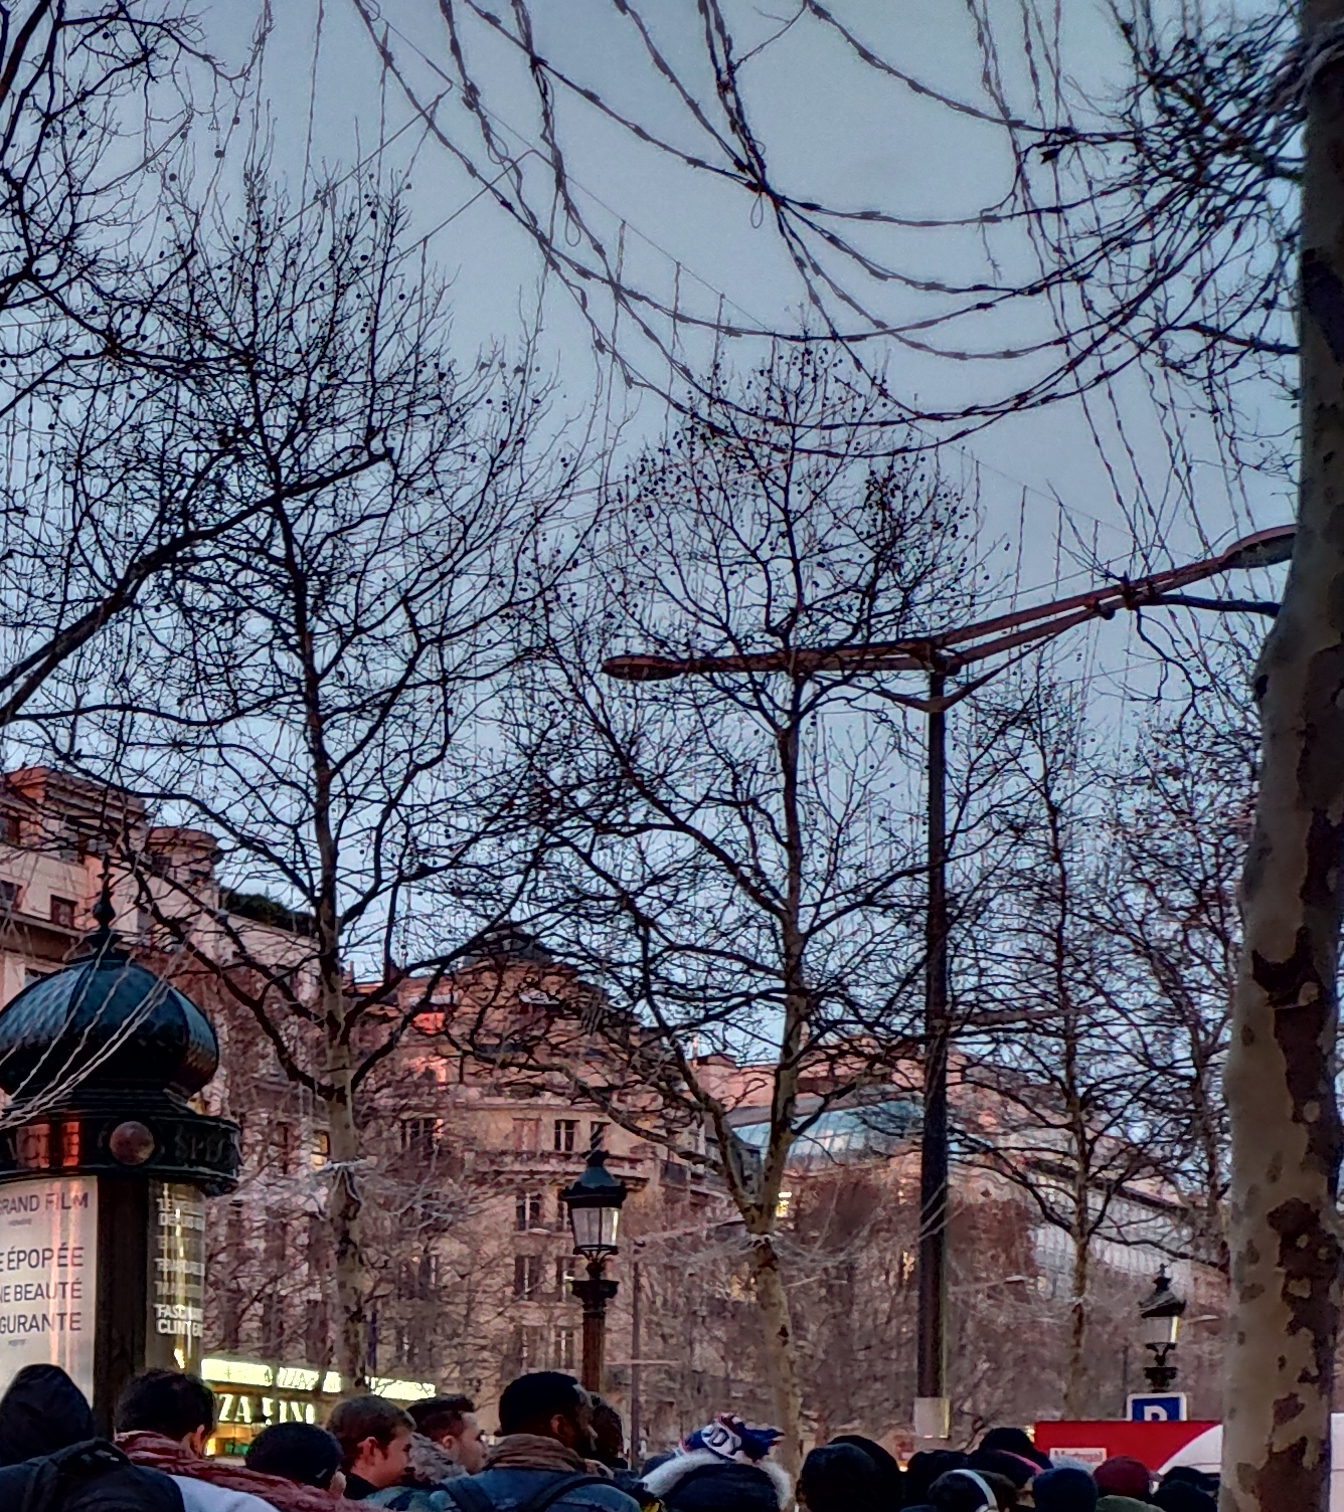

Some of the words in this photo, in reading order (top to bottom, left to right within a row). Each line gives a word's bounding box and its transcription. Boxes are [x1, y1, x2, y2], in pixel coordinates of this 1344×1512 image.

[45, 1192, 89, 1211] FILM
[6, 1242, 85, 1271] ÉPOPÉE
[13, 1277, 83, 1302] BEAUTÉ
